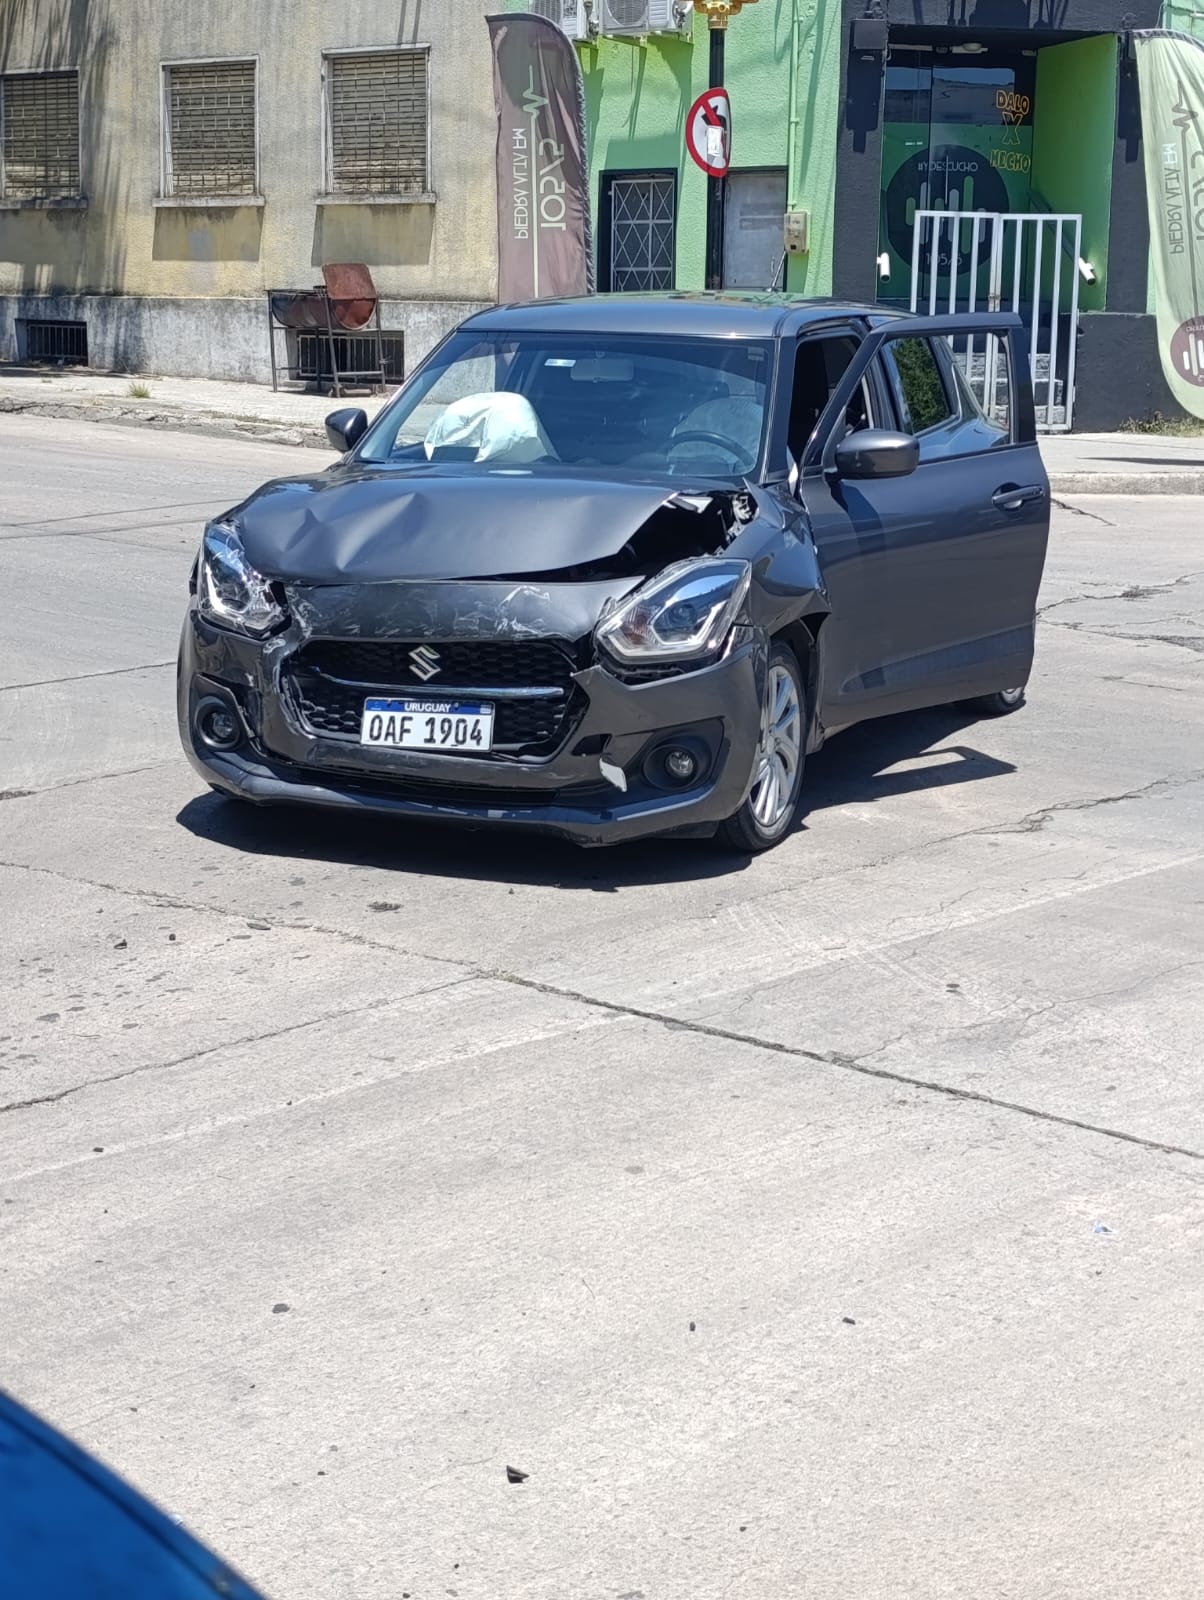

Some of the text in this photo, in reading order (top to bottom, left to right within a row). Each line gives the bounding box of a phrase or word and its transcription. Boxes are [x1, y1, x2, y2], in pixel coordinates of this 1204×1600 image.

[996, 89, 1030, 115] DALO
[404, 702, 451, 713] URUGUAY
[424, 716, 482, 746] 1904
